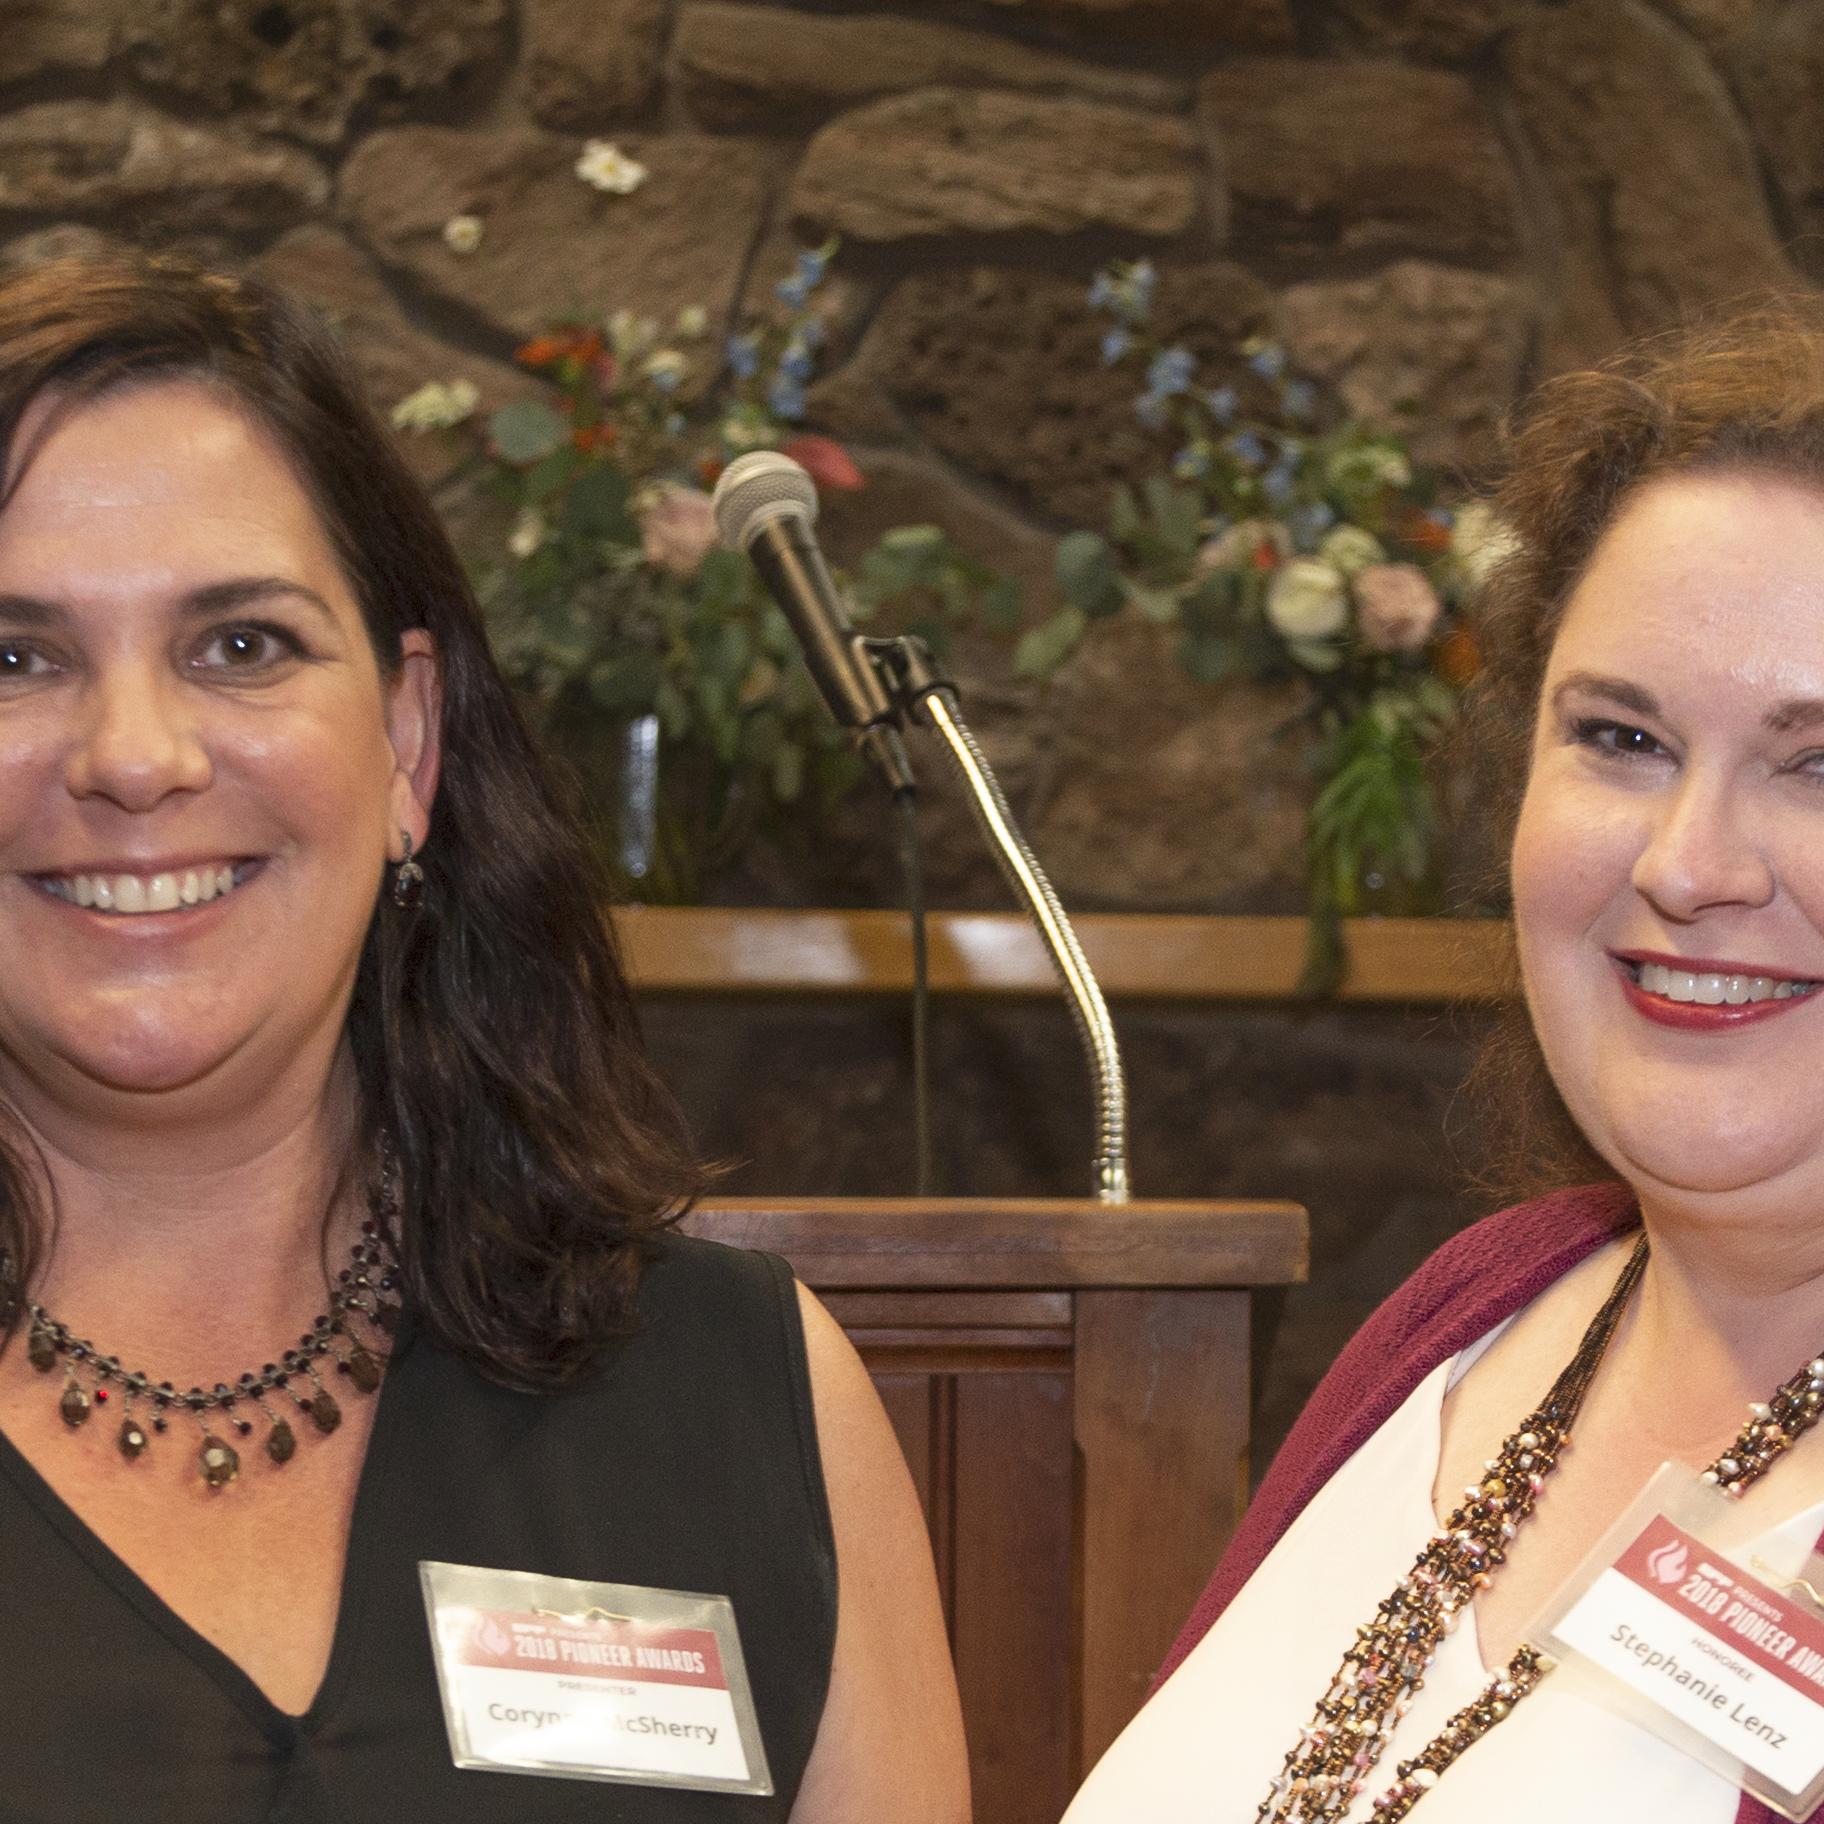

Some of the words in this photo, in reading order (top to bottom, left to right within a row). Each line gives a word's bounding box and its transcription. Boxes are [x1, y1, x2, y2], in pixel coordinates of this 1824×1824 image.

[513, 1634, 558, 1661] 2018
[560, 1639, 633, 1668] PIONEER
[636, 1646, 706, 1674] AWARDS
[1678, 1573, 1730, 1616] 2018
[1719, 1599, 1797, 1661] PIONEER
[1610, 1624, 1729, 1711] Stephanie
[1729, 1703, 1789, 1750] Lenz
